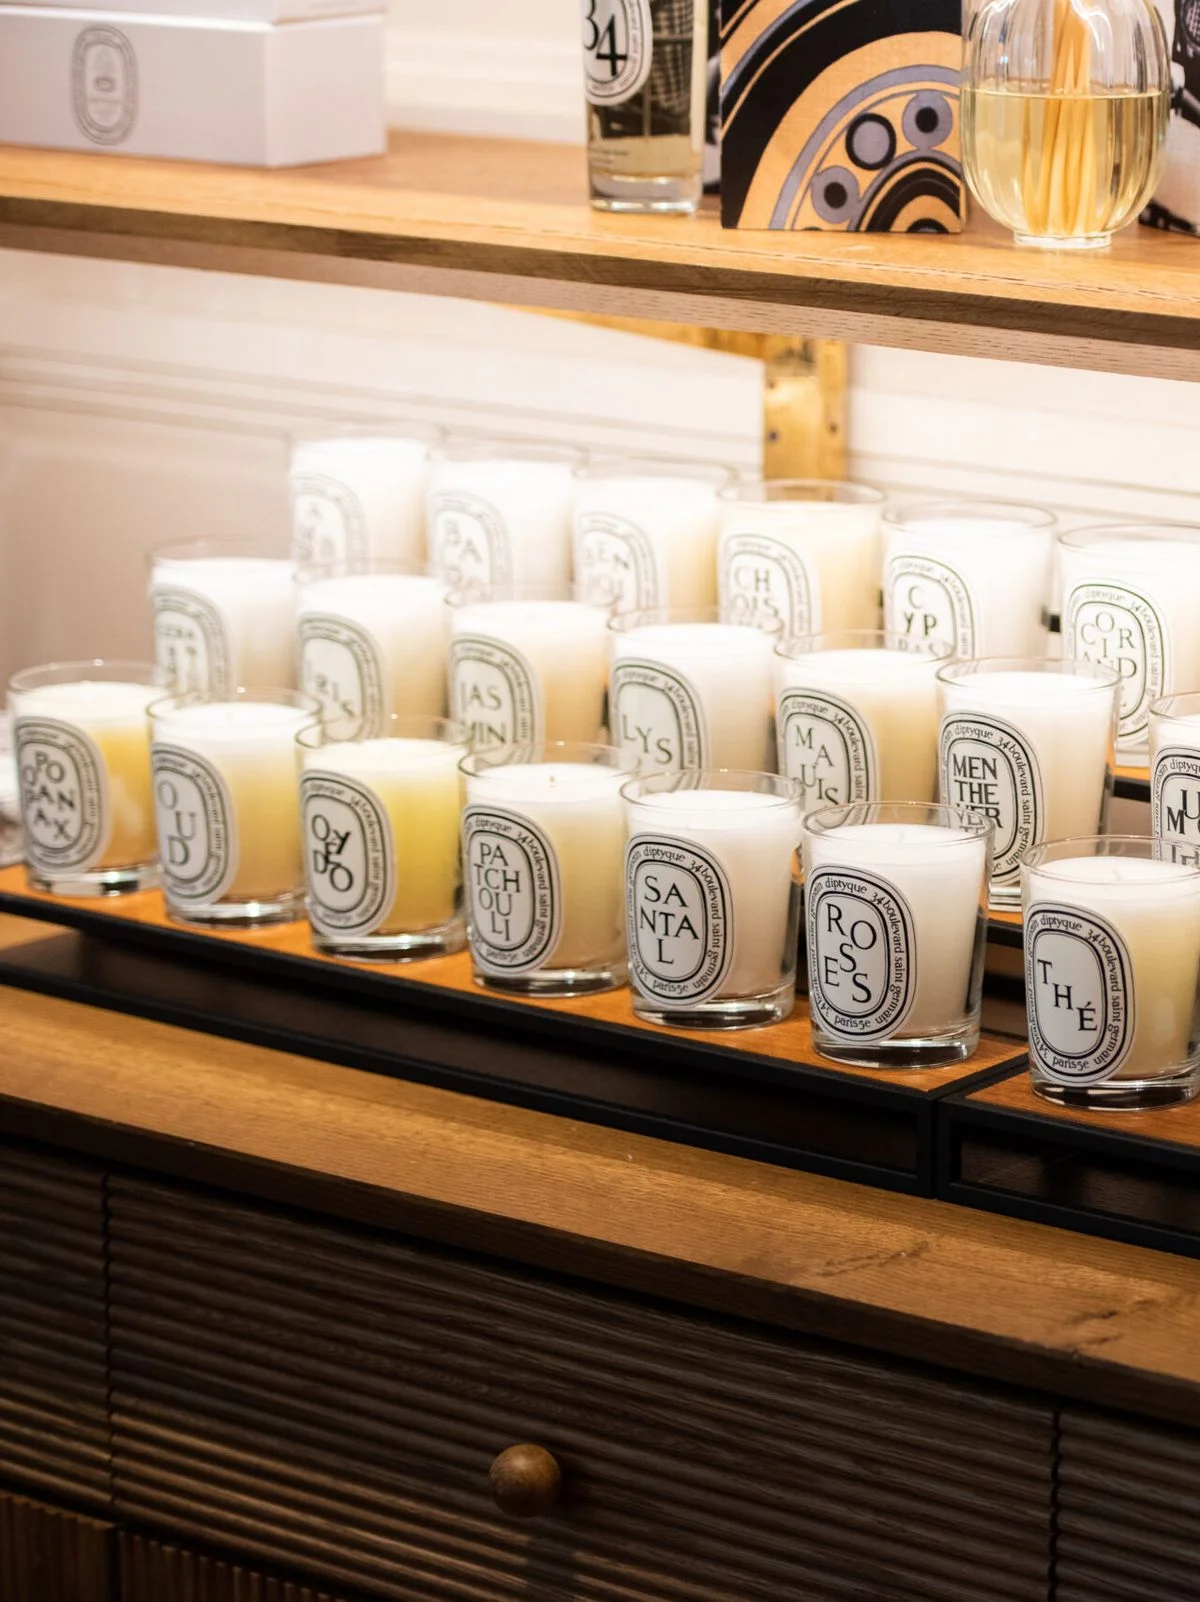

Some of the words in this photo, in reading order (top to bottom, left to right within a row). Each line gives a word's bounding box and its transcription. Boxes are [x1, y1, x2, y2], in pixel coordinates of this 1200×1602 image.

[622, 713, 673, 766] LYS
[795, 724, 835, 768] MA
[954, 724, 994, 742] diptyque
[996, 736, 1010, 750] 34
[952, 752, 999, 781] MEN
[1009, 744, 1033, 797] boulevard
[954, 779, 1000, 807] THE
[1022, 799, 1034, 825] saint
[479, 842, 509, 867] PA
[643, 846, 687, 863] diptyque
[1005, 826, 1032, 867] germain
[474, 863, 522, 894] TCH
[689, 859, 704, 874] 34
[644, 875, 689, 908] SA
[700, 867, 723, 920] boulevard
[824, 877, 868, 895] diptyque
[871, 892, 884, 906] 34
[478, 887, 513, 917] OU
[490, 910, 512, 942] LI
[640, 904, 700, 940] NTA
[711, 922, 724, 949] saint
[882, 900, 905, 954] boulevard
[1040, 914, 1083, 932] diptyque
[1086, 928, 1101, 943] 34
[656, 938, 676, 965] L
[1098, 935, 1121, 993] boulevard
[692, 949, 720, 989] germain
[894, 956, 906, 983] saint
[874, 983, 902, 1025] germain
[1037, 958, 1098, 1032] THÉ
[1111, 995, 1123, 1023] saint
[1093, 1023, 1121, 1066] germain
